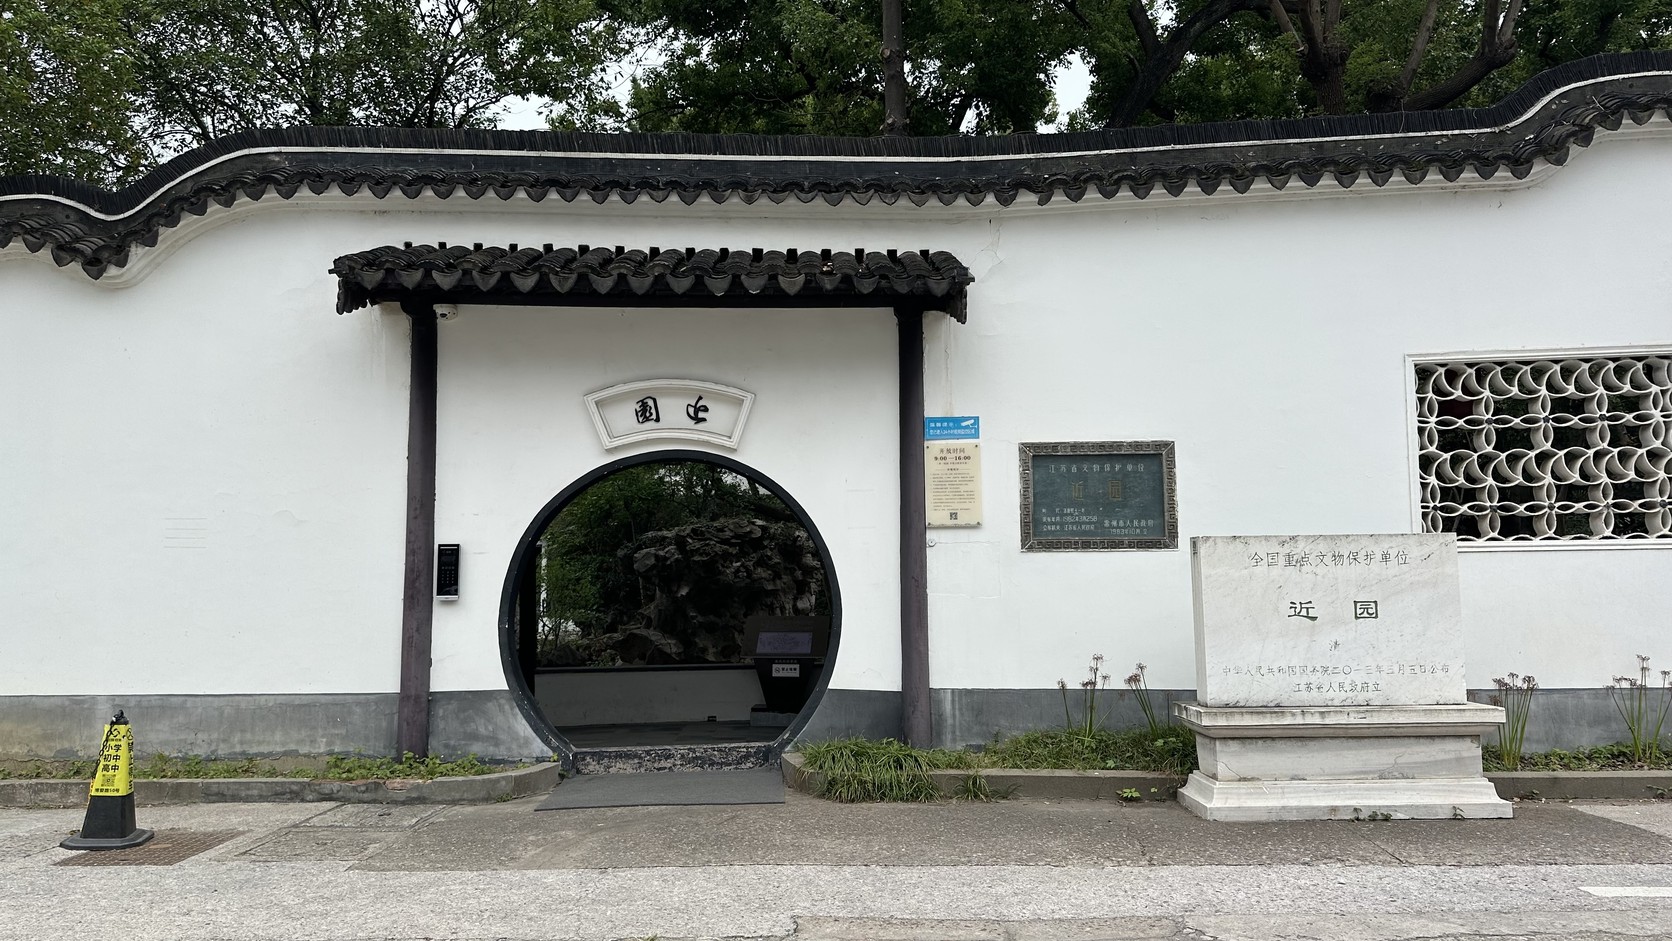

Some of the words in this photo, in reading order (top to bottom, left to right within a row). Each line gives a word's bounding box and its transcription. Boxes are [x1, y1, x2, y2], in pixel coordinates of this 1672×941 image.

[1048, 463, 1145, 473] 江苏省文物保护单位
[1250, 550, 1410, 568] 全国重点文物保护单位
[1292, 680, 1382, 694] 江苏省人民政府立
[104, 743, 122, 753] 小学
[103, 753, 121, 763] 初中
[101, 763, 120, 773] 高中
